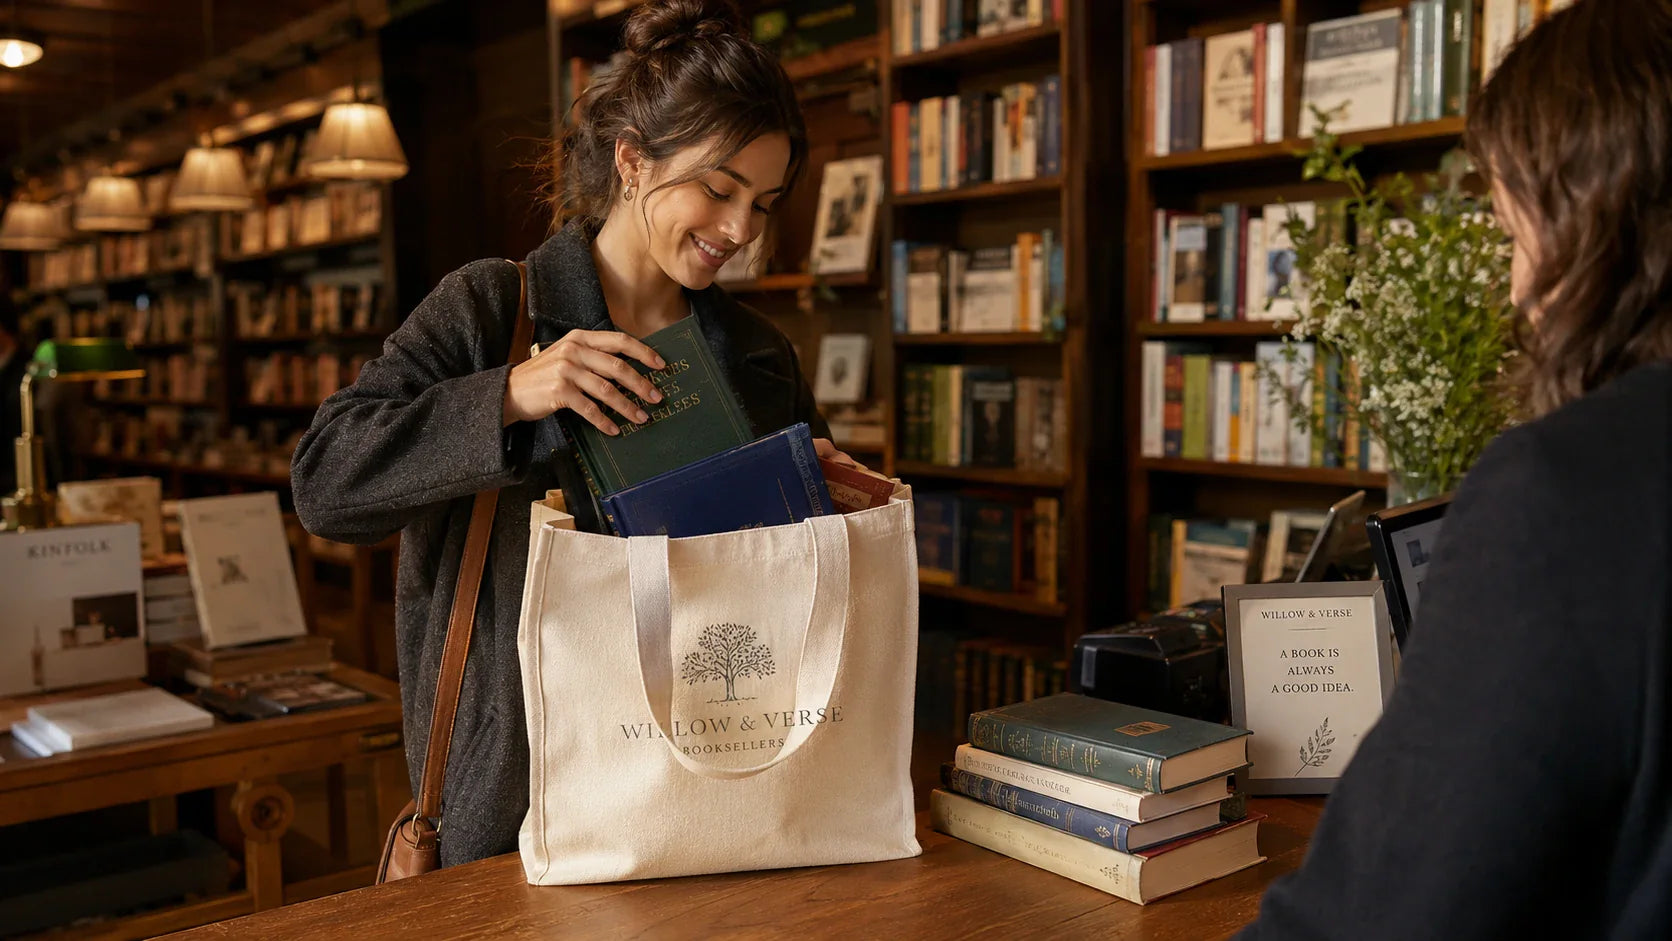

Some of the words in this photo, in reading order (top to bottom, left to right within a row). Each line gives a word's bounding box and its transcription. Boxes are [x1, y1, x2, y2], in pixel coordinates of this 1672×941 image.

[27, 540, 111, 559] KINFOLK
[1261, 610, 1305, 619] WILLOW
[1308, 610, 1316, 618] &
[1318, 608, 1352, 618] VERSE
[1280, 650, 1288, 658] A
[1291, 648, 1325, 658] BOOK
[1328, 648, 1339, 657] IS
[1287, 665, 1334, 675] ALWAYS
[1271, 684, 1279, 693] A
[1282, 683, 1319, 693] GOOD
[1322, 682, 1354, 692] IDEA.
[740, 715, 756, 732] &
[763, 706, 844, 729] VERSE
[683, 738, 785, 756] BOOKSELLERS
